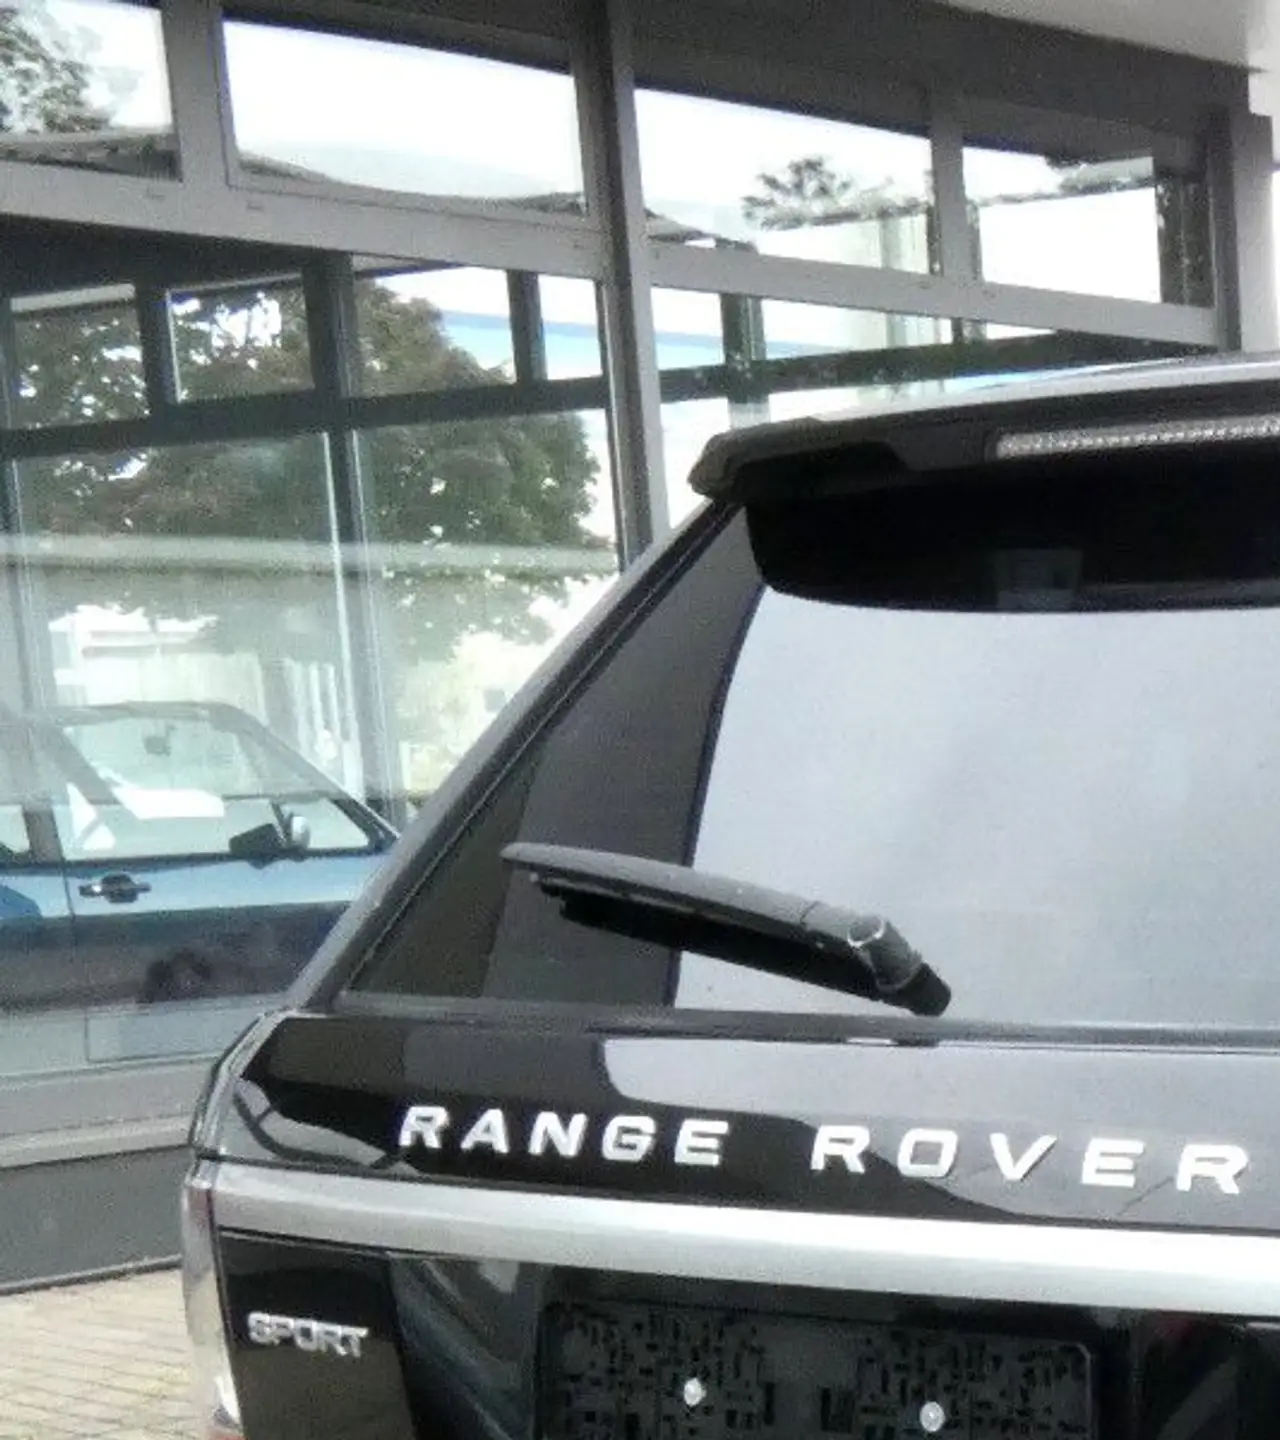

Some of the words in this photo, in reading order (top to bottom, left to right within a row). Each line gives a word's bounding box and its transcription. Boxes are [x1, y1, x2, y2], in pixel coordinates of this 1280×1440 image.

[398, 1105, 730, 1166] RANGE
[809, 1124, 1249, 1195] ROVER
[247, 1310, 369, 1358] SPORT
